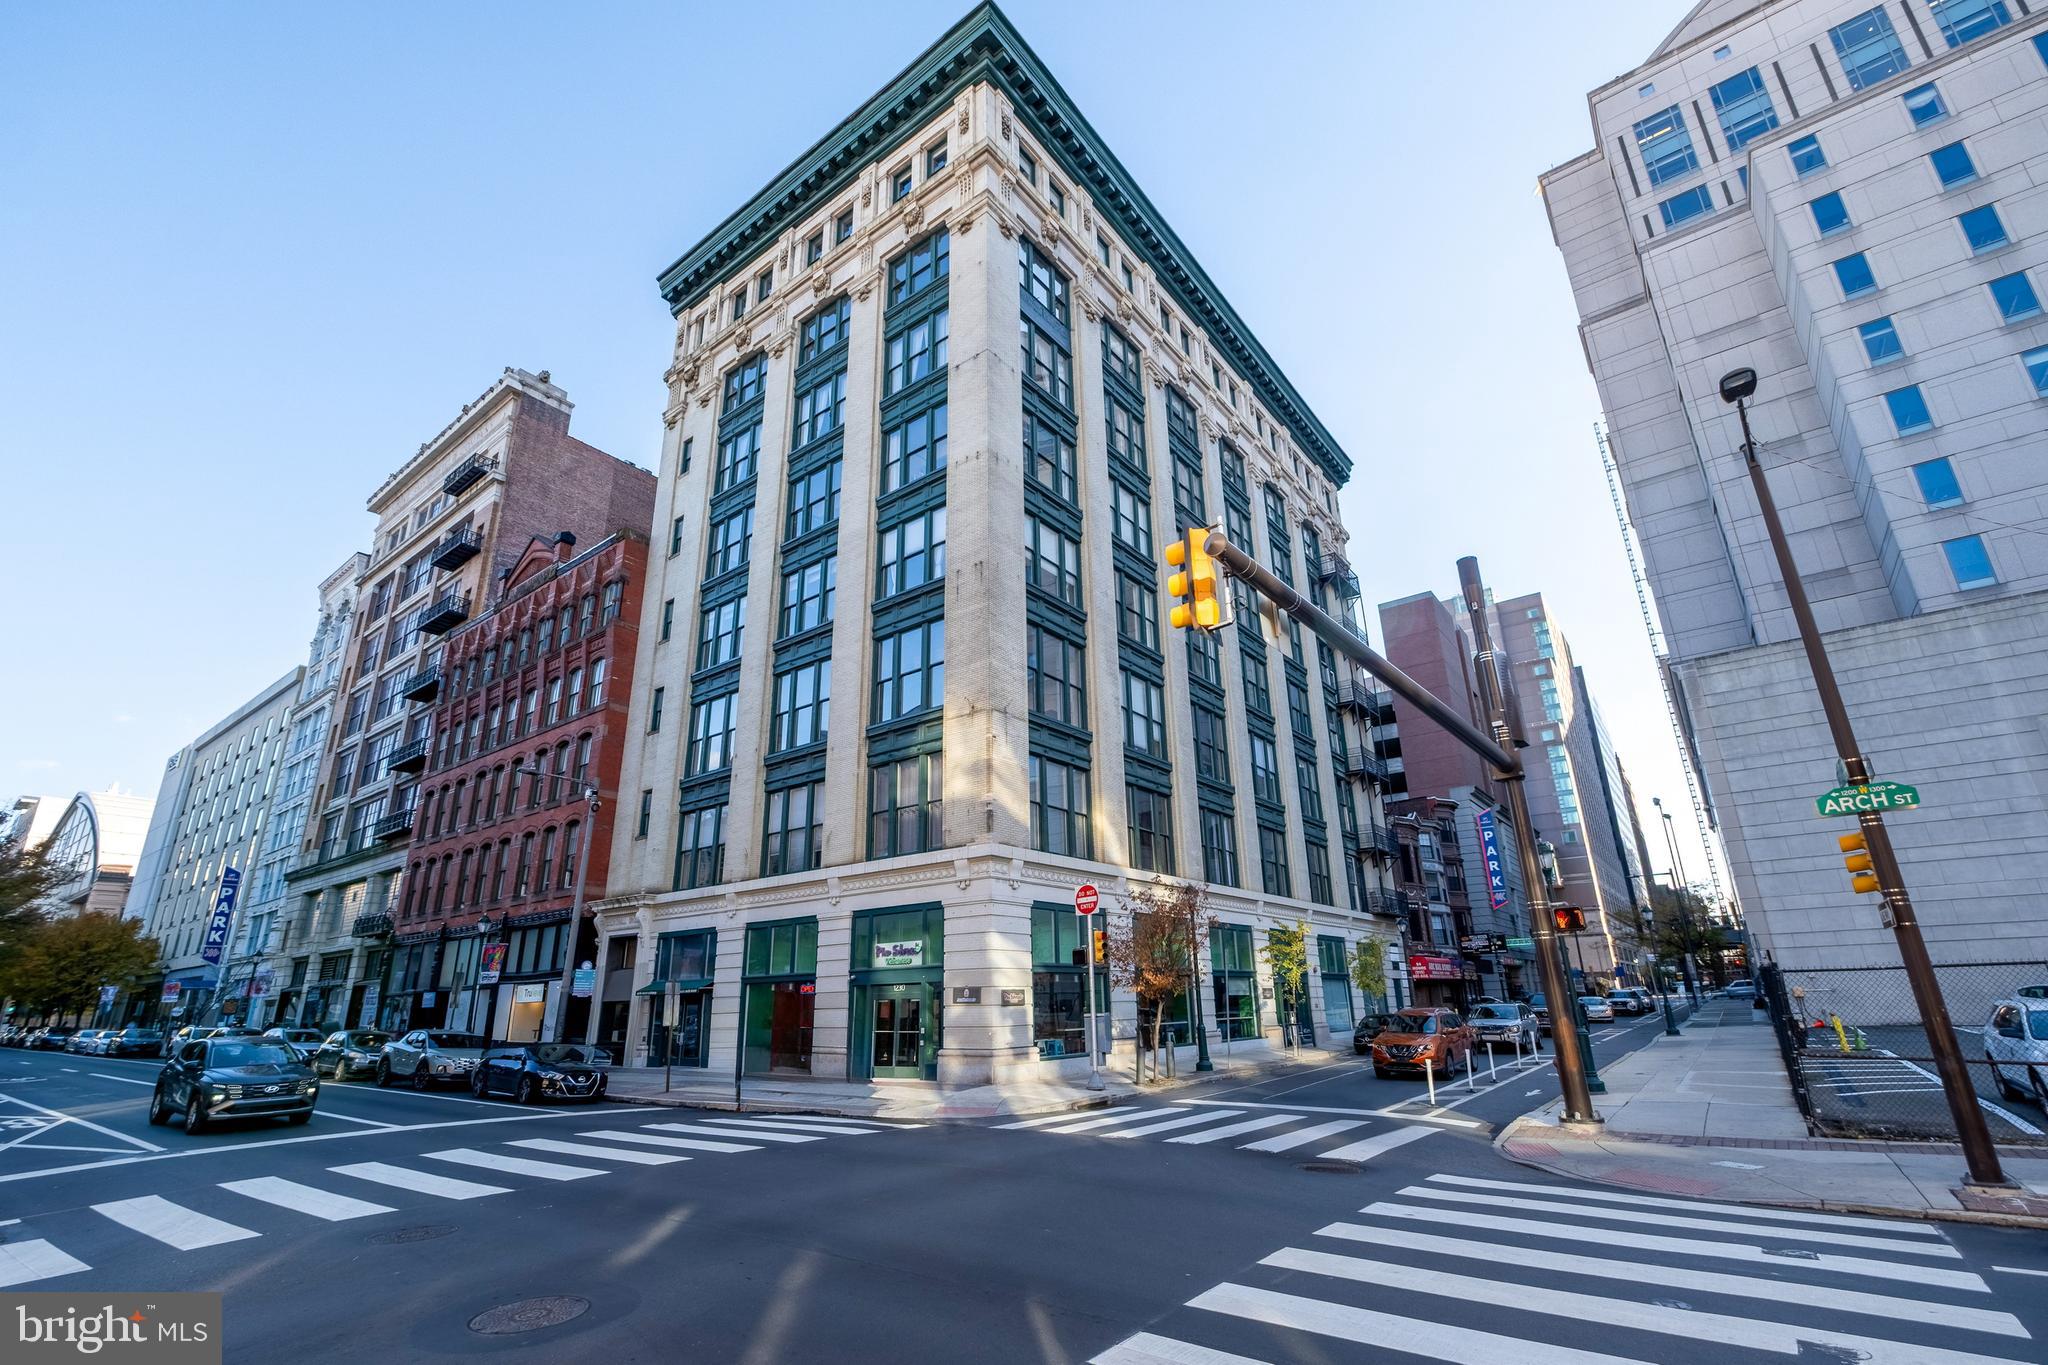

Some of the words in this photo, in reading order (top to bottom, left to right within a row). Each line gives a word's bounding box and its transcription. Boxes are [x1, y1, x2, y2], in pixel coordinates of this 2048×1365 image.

[1825, 793, 1889, 814] ARCH
[1894, 793, 1912, 804] ST
[1858, 785, 1868, 794] W
[1869, 785, 1886, 793] 1300
[1483, 831, 1503, 887] PARK
[209, 887, 233, 943] PARK
